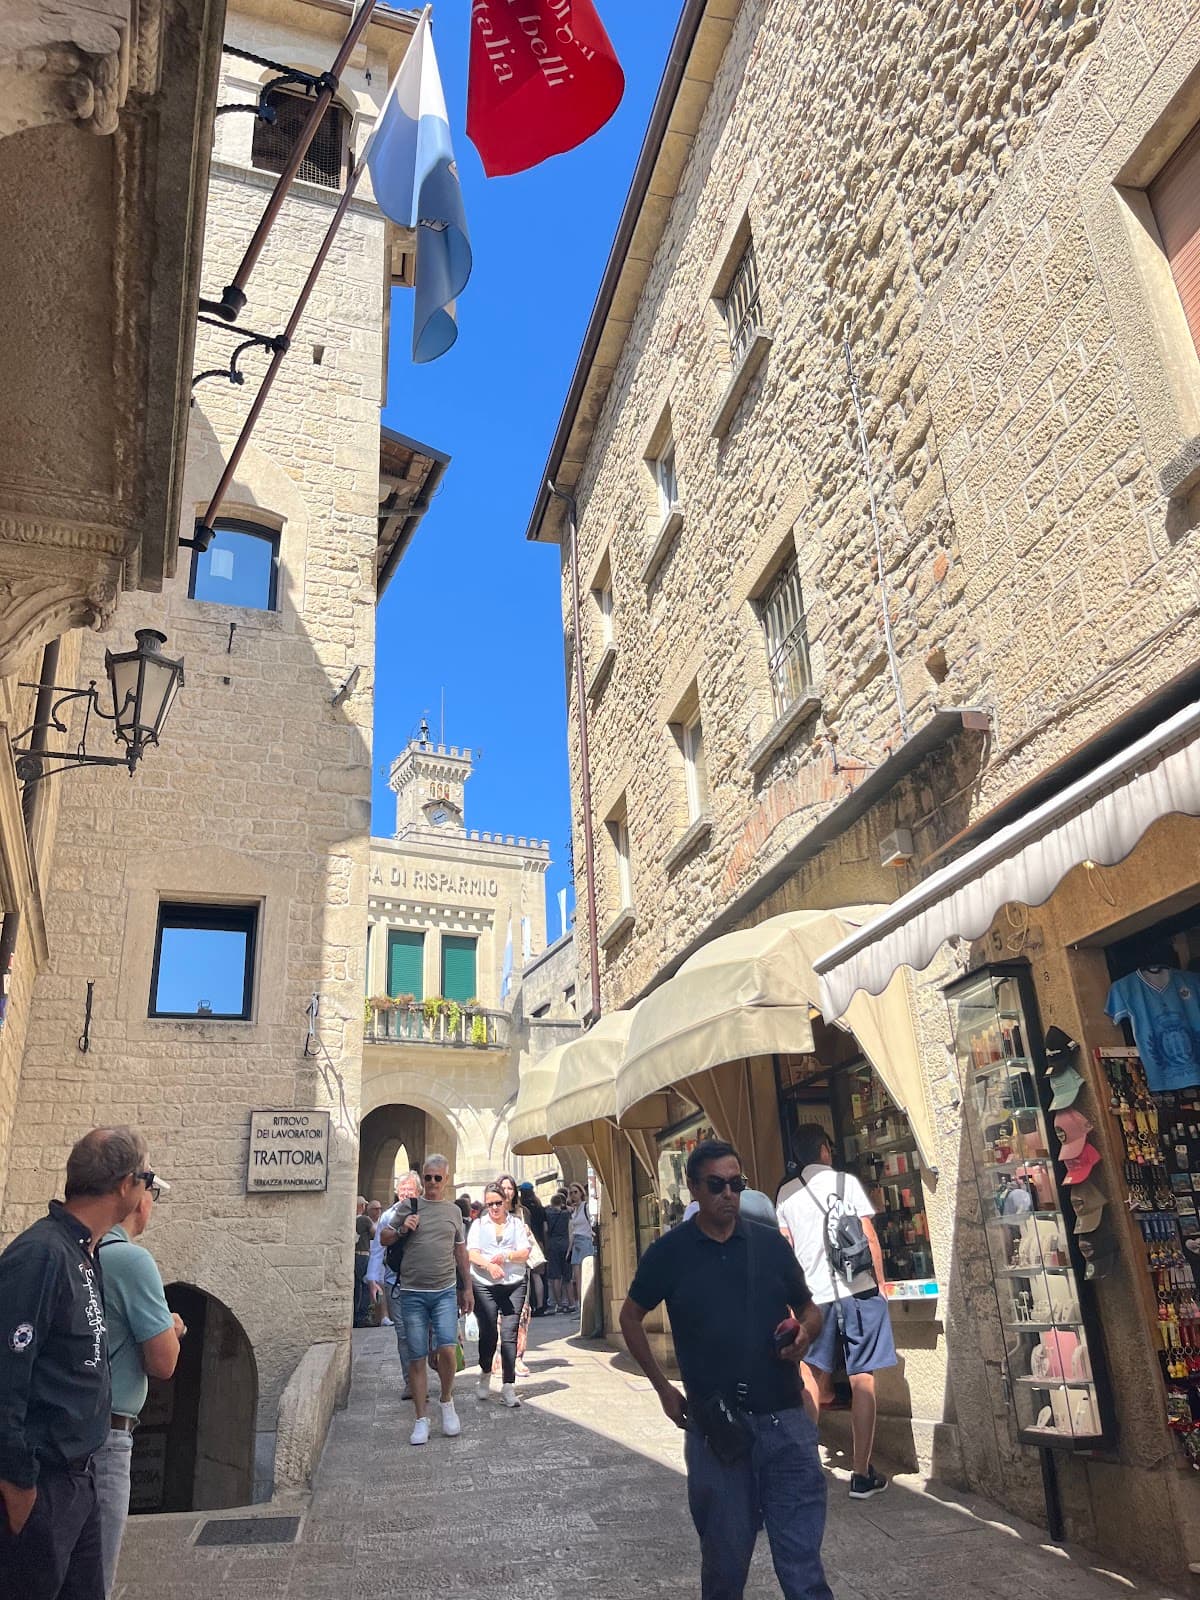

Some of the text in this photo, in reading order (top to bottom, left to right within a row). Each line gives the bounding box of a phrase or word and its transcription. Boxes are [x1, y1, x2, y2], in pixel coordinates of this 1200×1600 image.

[518, 15, 575, 87] belli
[368, 863, 498, 898] A DI RISPARMIO
[273, 1116, 309, 1126] RITROVO
[256, 1129, 323, 1139] DEI LAVORATORI
[253, 1150, 323, 1166] TRATTORIA
